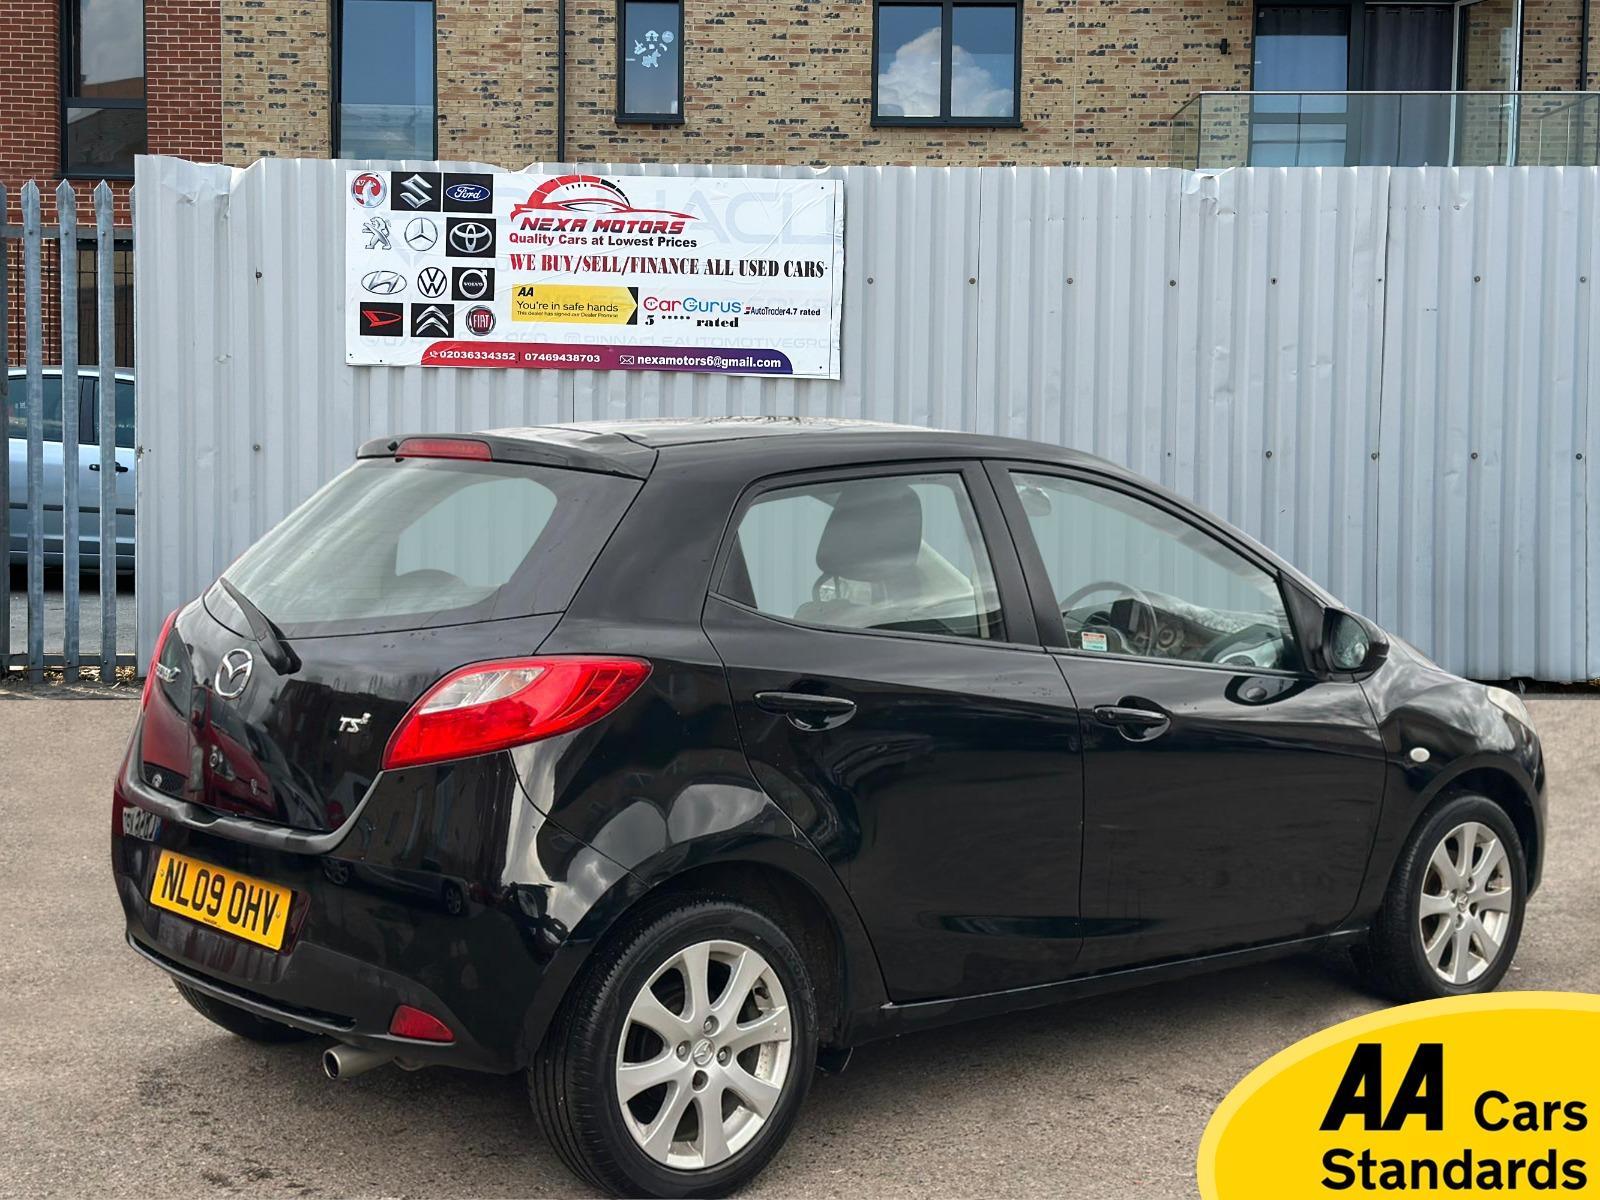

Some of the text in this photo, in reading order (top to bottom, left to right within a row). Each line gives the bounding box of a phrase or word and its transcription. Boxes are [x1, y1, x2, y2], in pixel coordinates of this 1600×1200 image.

[454, 186, 481, 199] Ford
[520, 217, 686, 235] NEXA MOTORS
[509, 232, 697, 248] Quality Cars at Lowest Prices
[510, 254, 536, 271] WE
[541, 254, 699, 275] BUY/SELL/FINANCE
[704, 258, 734, 276] ALL
[739, 259, 780, 277] USED
[517, 287, 534, 297] AA
[516, 301, 619, 312] You're in safe hands
[643, 296, 742, 313] CarGurus
[799, 308, 821, 316] rated
[473, 314, 490, 328] FIAT
[644, 314, 739, 328] 5 rated
[439, 350, 781, 368] 02036334352 07469438703 nexamotors6@gmail.com
[161, 858, 280, 936] NL09 OHV
